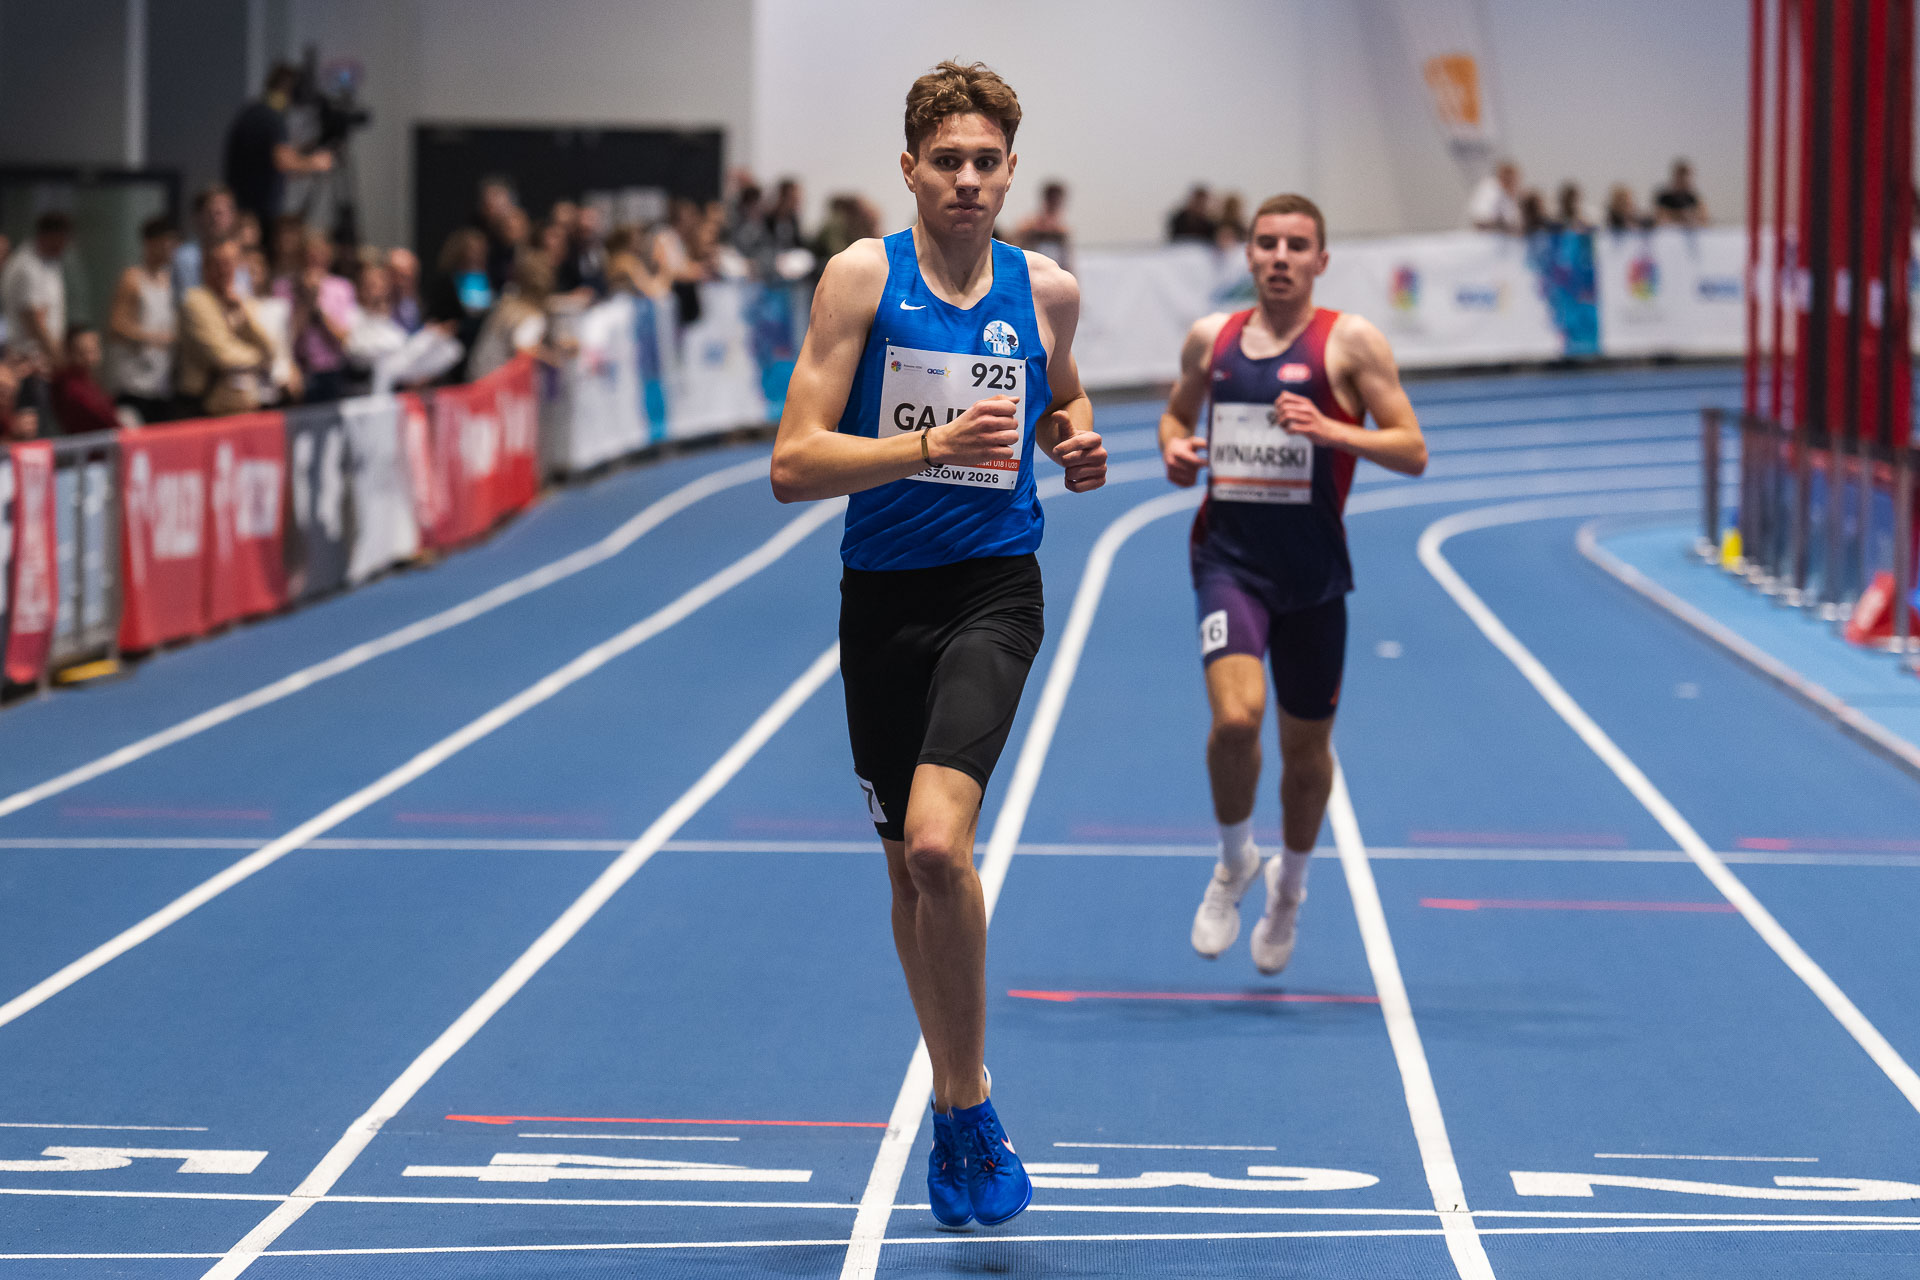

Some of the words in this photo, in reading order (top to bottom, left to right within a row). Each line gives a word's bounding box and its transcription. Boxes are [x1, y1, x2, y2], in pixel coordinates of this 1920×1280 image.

[971, 363, 1017, 390] 925
[993, 460, 1005, 468] U18
[1008, 461, 1018, 469] U20
[967, 471, 999, 484] 2026
[1209, 619, 1223, 642] 6
[402, 1153, 813, 1183] 4
[1509, 1171, 1920, 1202] 2
